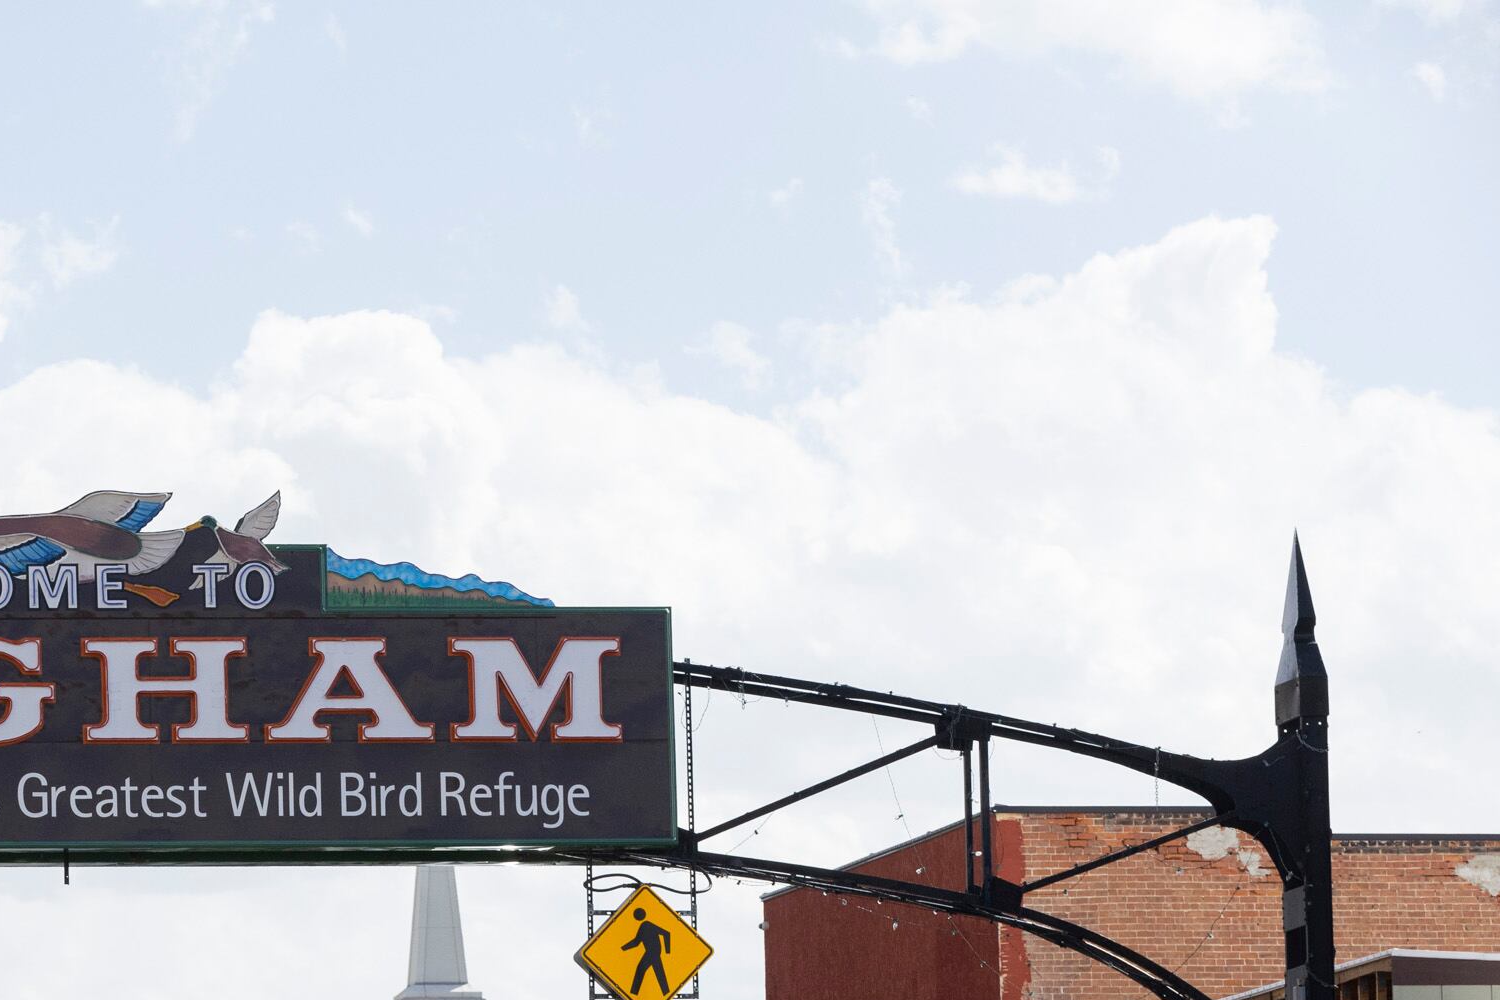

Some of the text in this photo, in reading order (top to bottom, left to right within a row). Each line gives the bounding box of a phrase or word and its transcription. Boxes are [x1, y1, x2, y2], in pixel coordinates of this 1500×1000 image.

[192, 562, 275, 610] TO
[17, 771, 207, 819] Greatest
[225, 771, 323, 818] Wild
[340, 771, 422, 817] Bird
[440, 771, 590, 829] Refuge
